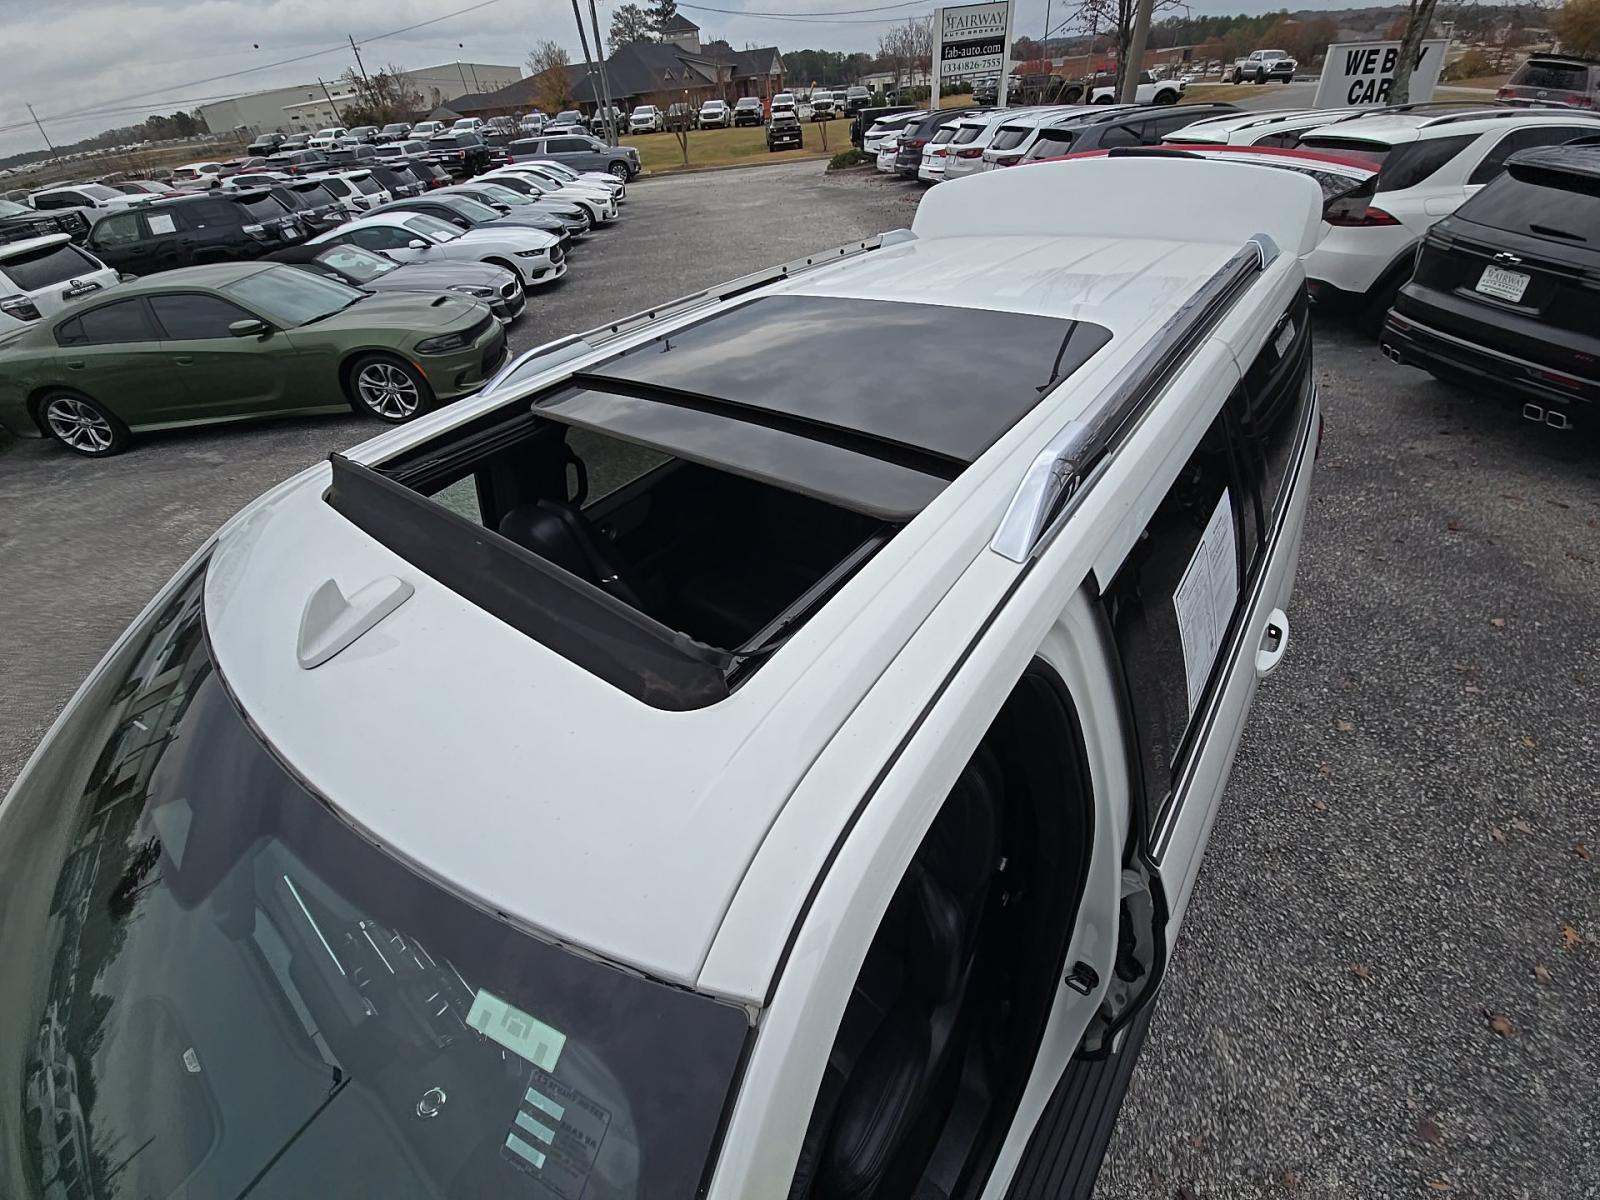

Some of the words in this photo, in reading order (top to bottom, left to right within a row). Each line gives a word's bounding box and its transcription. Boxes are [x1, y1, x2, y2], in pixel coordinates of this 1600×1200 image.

[946, 12, 1005, 29] FAIRWAY
[945, 44, 1001, 58] fab-auto.com
[943, 58, 1001, 73] (334)826-7555
[1345, 49, 1380, 76] WE
[1380, 46, 1430, 73] BY
[1347, 78, 1394, 105] CAR
